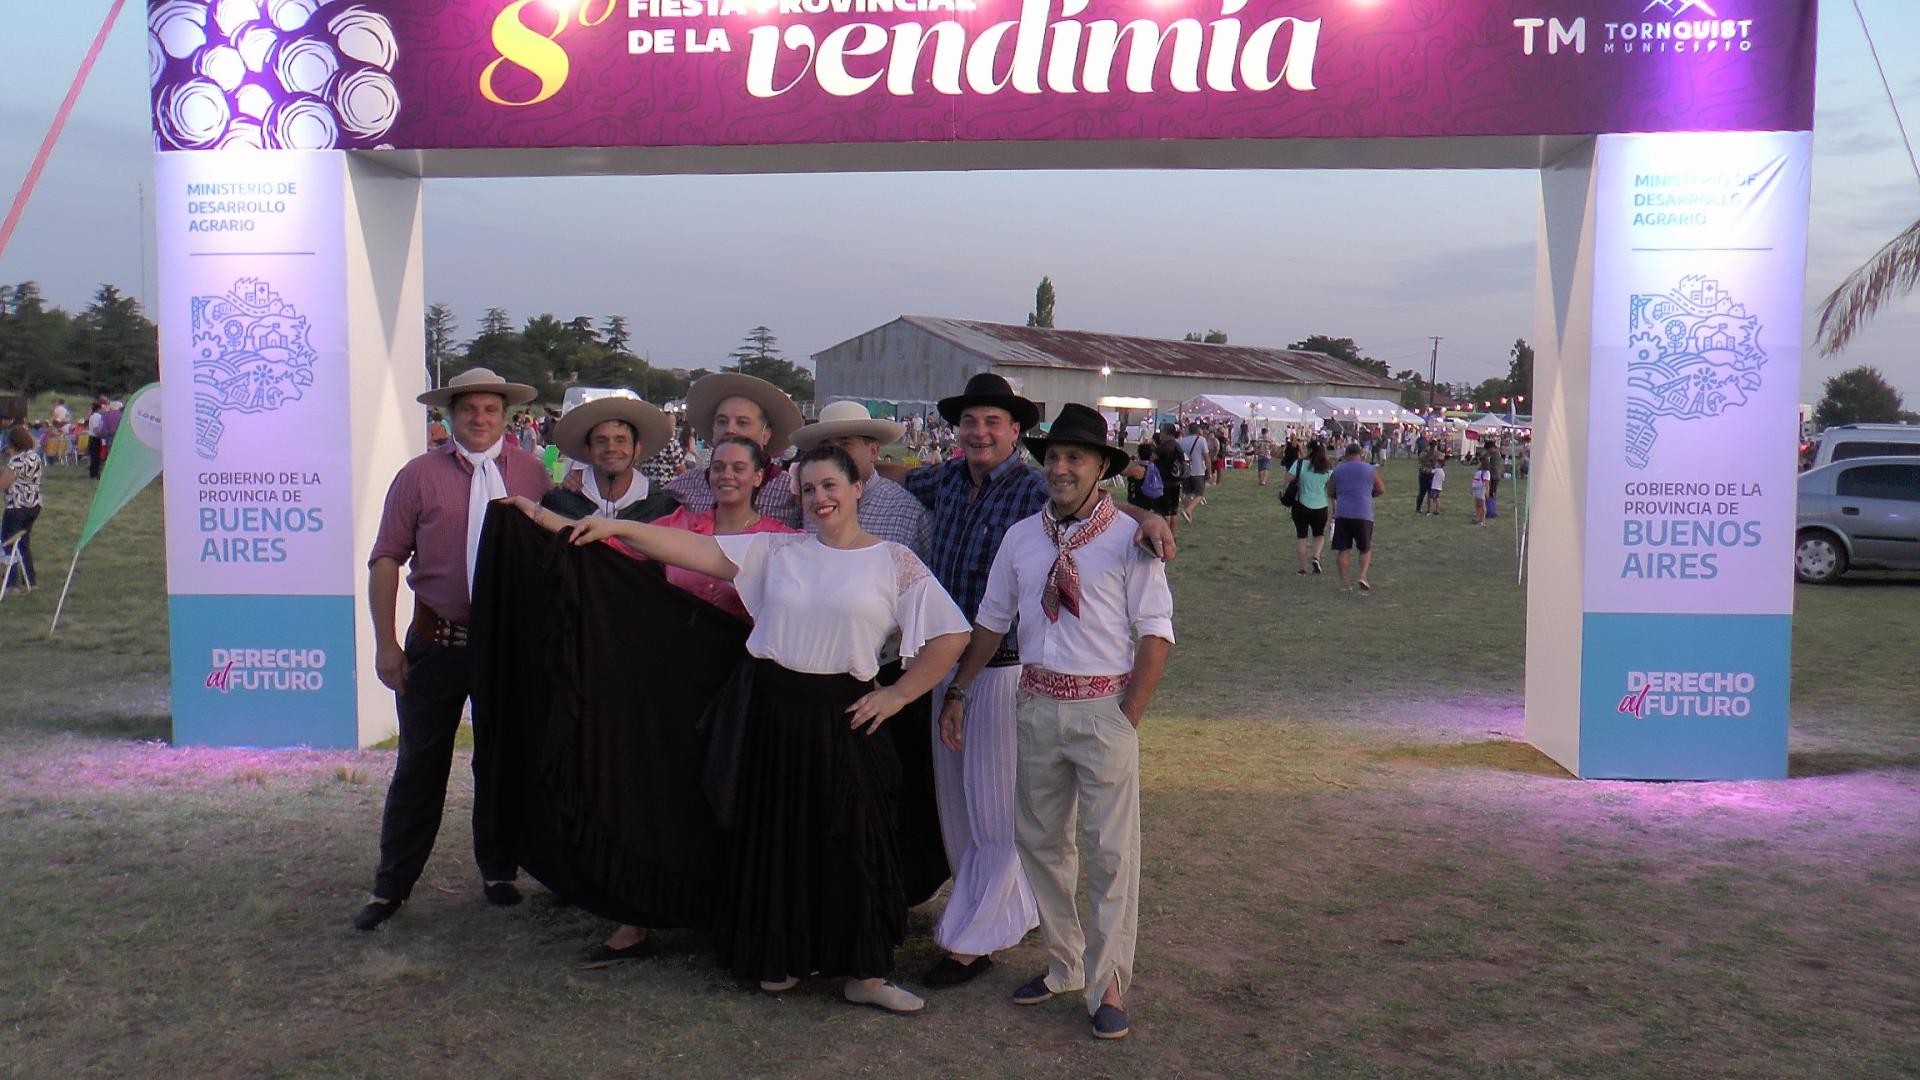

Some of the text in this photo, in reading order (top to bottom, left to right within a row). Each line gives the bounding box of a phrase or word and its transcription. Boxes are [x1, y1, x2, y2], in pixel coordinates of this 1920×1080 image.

[627, 0, 746, 17] FIESTA
[1513, 17, 1586, 55] TM
[1604, 19, 1753, 40] TORNQUIST
[627, 28, 732, 54] DE LA
[746, 0, 1322, 98] vendimia
[1604, 41, 1752, 53] MUNICIPIO
[187, 182, 297, 196] MINISTERIO DE
[188, 200, 285, 214] DESARROLLO
[1633, 193, 1743, 207] DESARROLLO
[189, 219, 255, 232] AGRARIO
[1632, 212, 1707, 226] AGRARIO
[198, 472, 321, 486] GOBIERNO DE LA
[1625, 482, 1762, 496] GOBIERNO DE LA
[199, 489, 302, 503] PROVINCIA DE
[1624, 501, 1739, 515] PROVINCIA DE
[199, 507, 324, 533] BUENOS
[1623, 520, 1762, 547] BUENOS
[200, 537, 287, 563] AIRES
[1621, 553, 1718, 579] AIRES
[212, 648, 326, 668] DERECHO
[205, 661, 324, 693] al FUTURO
[1627, 671, 1755, 693] DERECHO
[1617, 684, 1751, 719] al FUTURO
